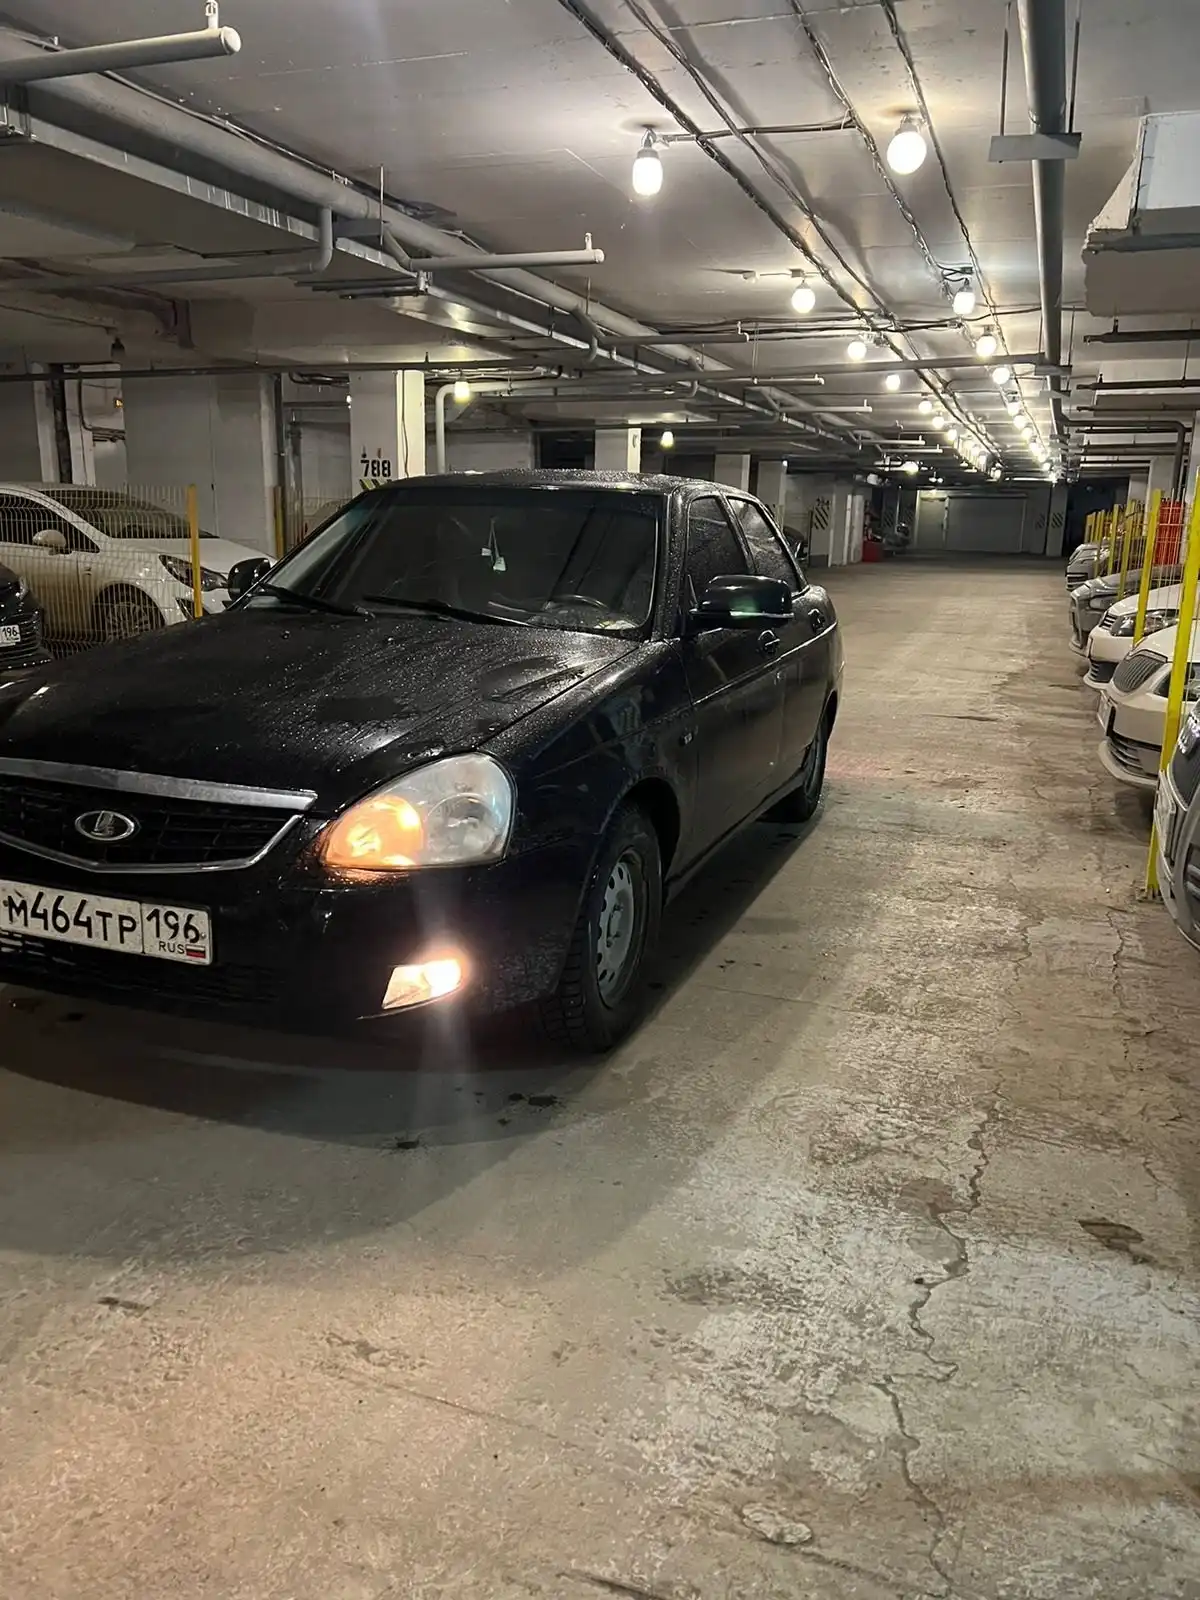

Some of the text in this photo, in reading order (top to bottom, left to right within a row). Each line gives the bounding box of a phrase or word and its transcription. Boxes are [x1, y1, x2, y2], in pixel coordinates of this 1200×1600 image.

[360, 459, 391, 477] 788
[3, 626, 18, 637] 196
[146, 908, 200, 943] 196
[158, 940, 185, 954] RUS
